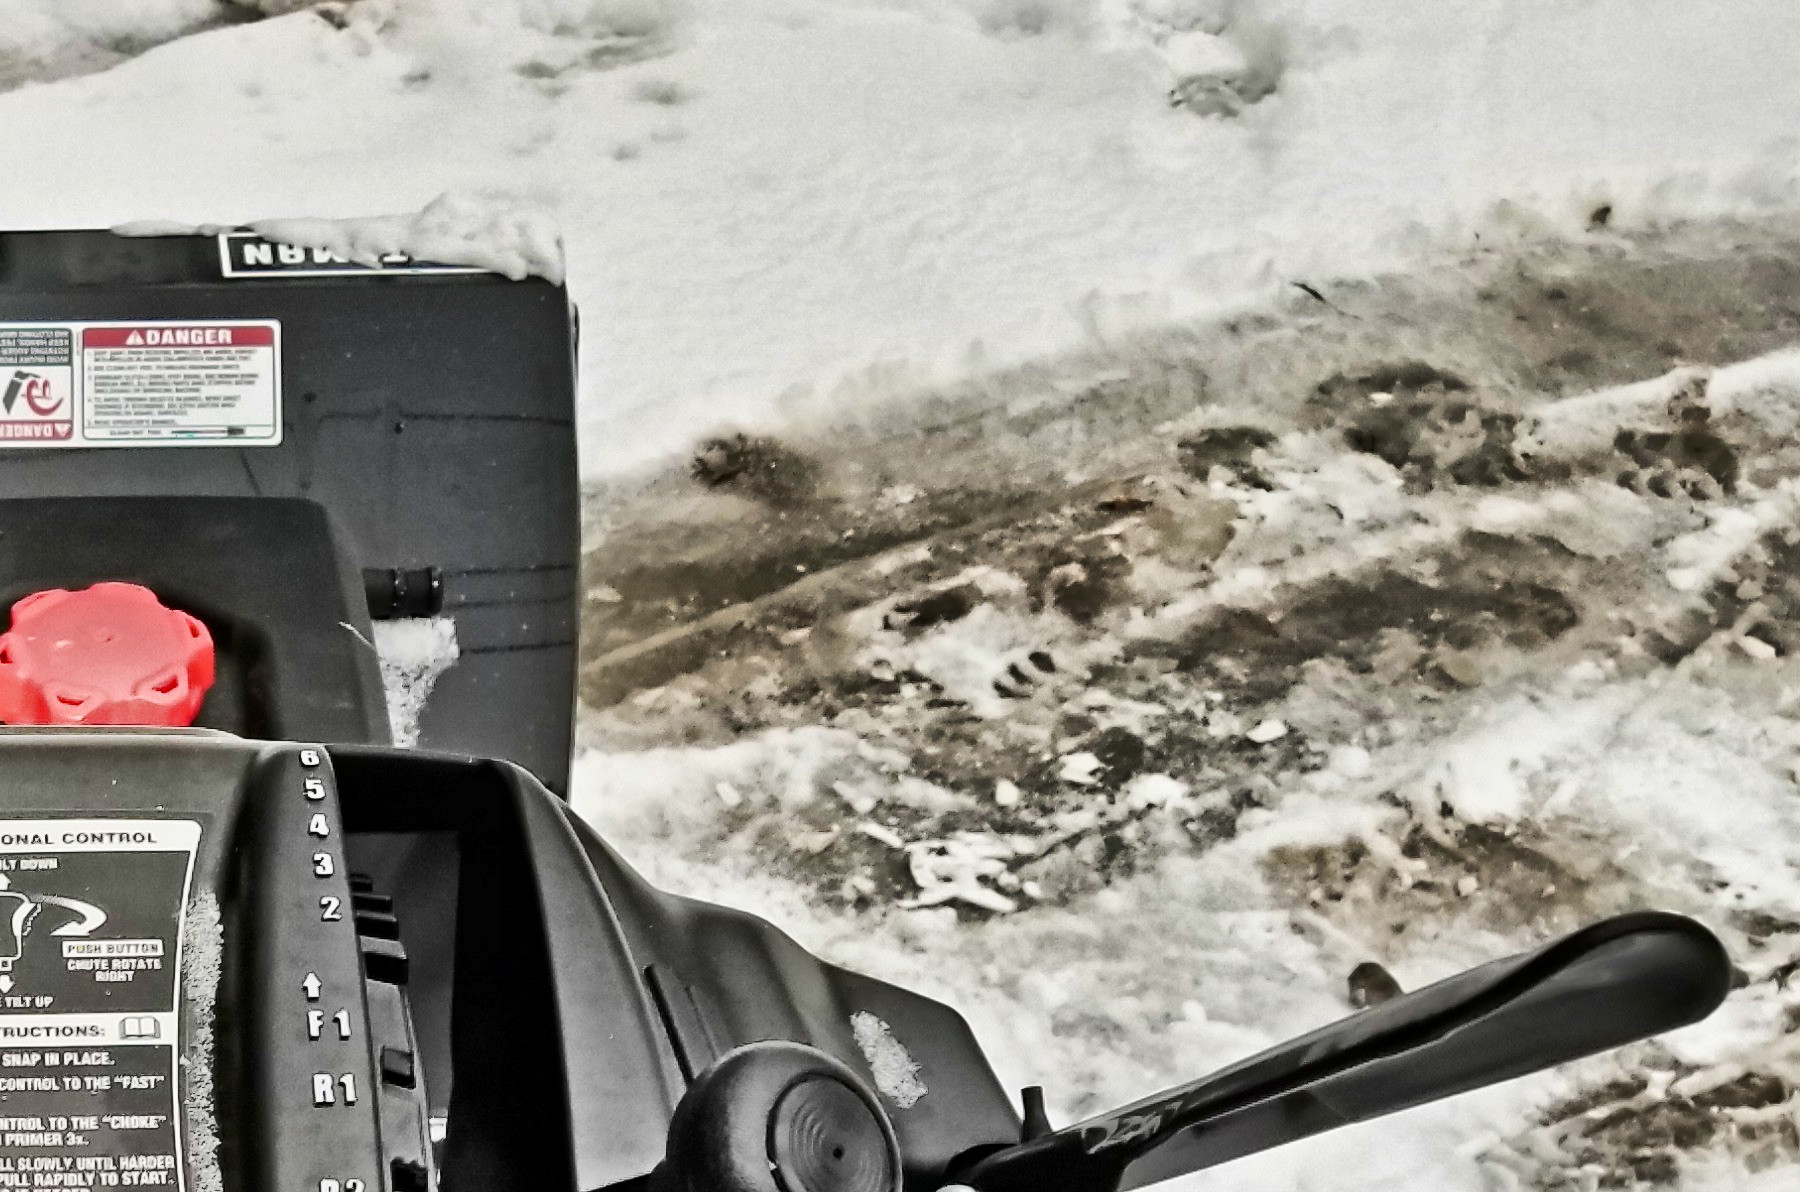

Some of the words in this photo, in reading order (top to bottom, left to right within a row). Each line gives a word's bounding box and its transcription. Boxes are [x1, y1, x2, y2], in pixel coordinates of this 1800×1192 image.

[146, 330, 232, 344] DANGER
[301, 750, 319, 766] 6
[305, 778, 326, 799] 5
[309, 812, 330, 837] 4
[62, 832, 158, 845] CONTROL
[20, 858, 58, 870] DOWN
[314, 852, 335, 877] 3
[320, 896, 342, 922] 2
[68, 944, 102, 954] PUSH
[107, 943, 158, 954] BUTTON
[67, 959, 109, 971] CHUTE
[112, 959, 162, 970] ROTATE
[95, 970, 135, 982] RIGHT
[5, 996, 33, 1008] TILT
[35, 995, 53, 1007] UP
[2, 1053, 41, 1067] SNAP
[45, 1052, 59, 1066] IN
[64, 1052, 115, 1065] PLACE.
[63, 1076, 81, 1091] TO
[84, 1076, 111, 1090] THE
[313, 1072, 358, 1107] R1
[49, 1116, 68, 1131] TO
[70, 1116, 99, 1130] THE
[5, 1132, 63, 1147] PRIMER
[18, 1157, 73, 1171] SLOWLY
[76, 1156, 116, 1171] UNTIL
[120, 1155, 175, 1170] HARDER
[34, 1172, 95, 1187] RAPIDLY
[100, 1172, 119, 1186] TO
[122, 1171, 176, 1186] START.
